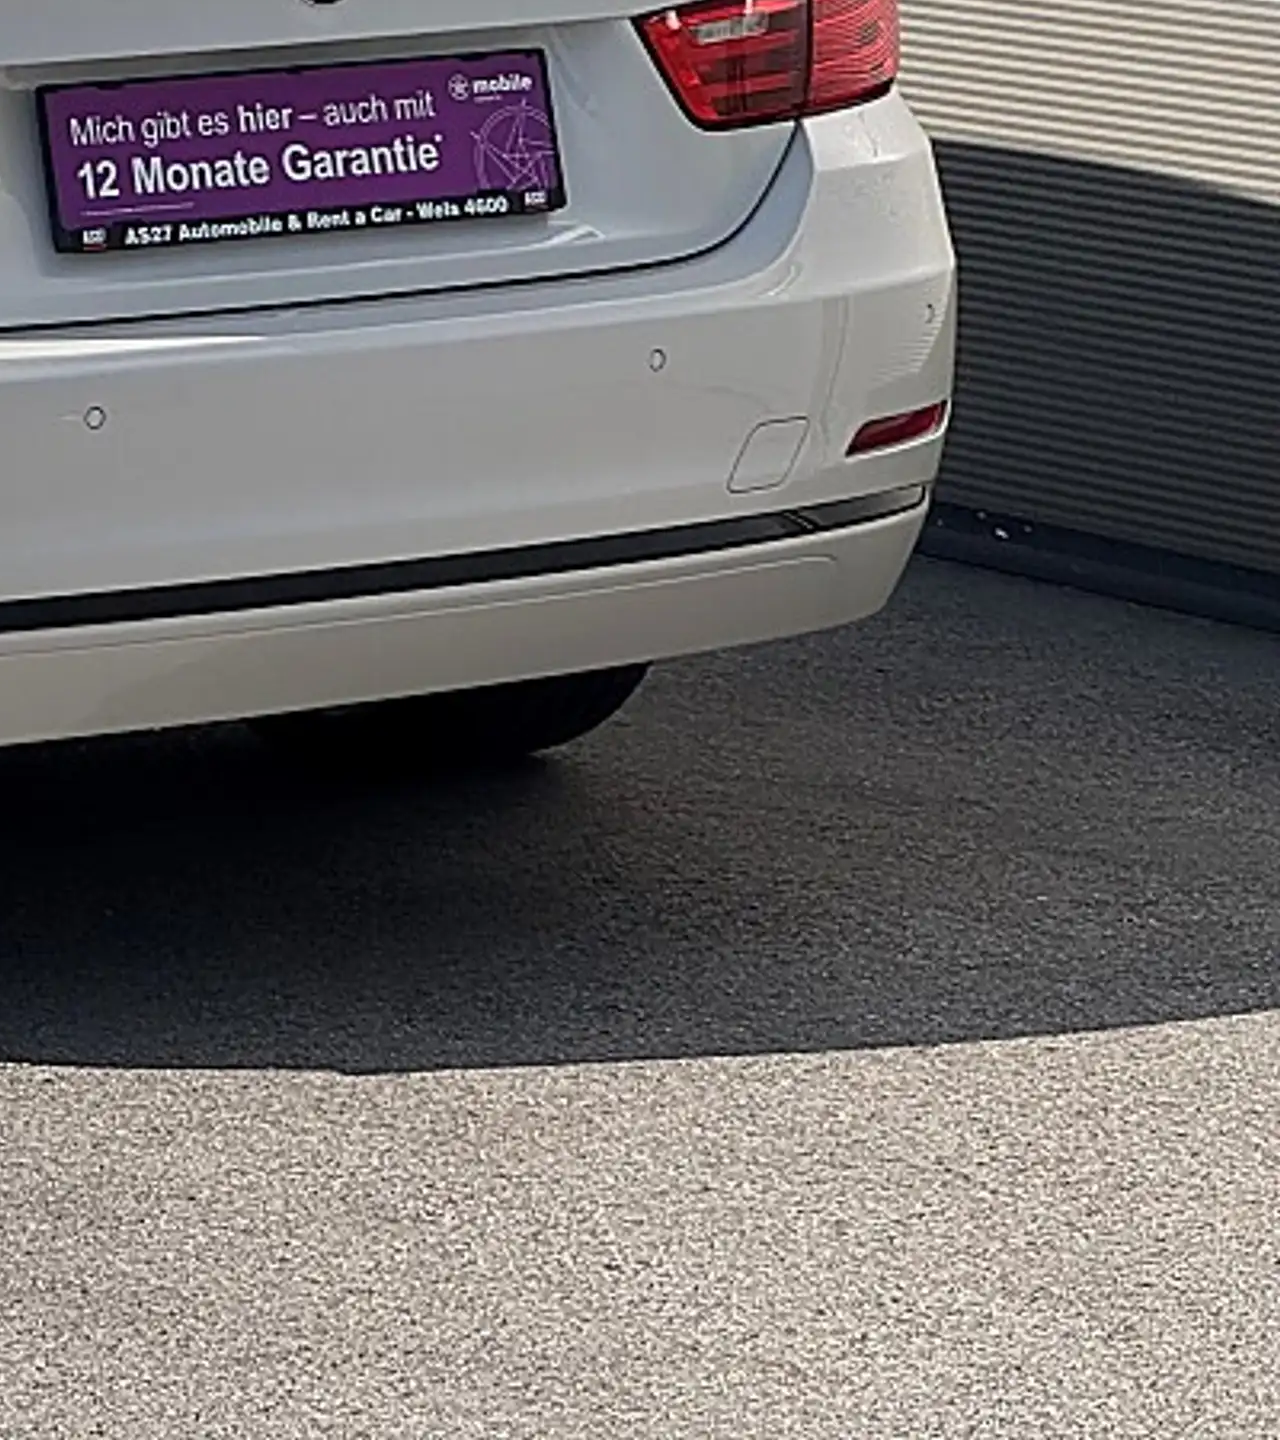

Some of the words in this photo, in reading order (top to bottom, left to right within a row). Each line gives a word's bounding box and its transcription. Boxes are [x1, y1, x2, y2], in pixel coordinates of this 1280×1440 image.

[472, 73, 532, 94] mobile
[70, 114, 135, 146] Mich
[141, 111, 192, 148] gibt
[198, 111, 230, 136] es
[237, 103, 292, 133] hier
[323, 93, 389, 126] auch
[394, 90, 437, 120] mit
[78, 160, 120, 199] 12
[132, 150, 270, 194] Monate
